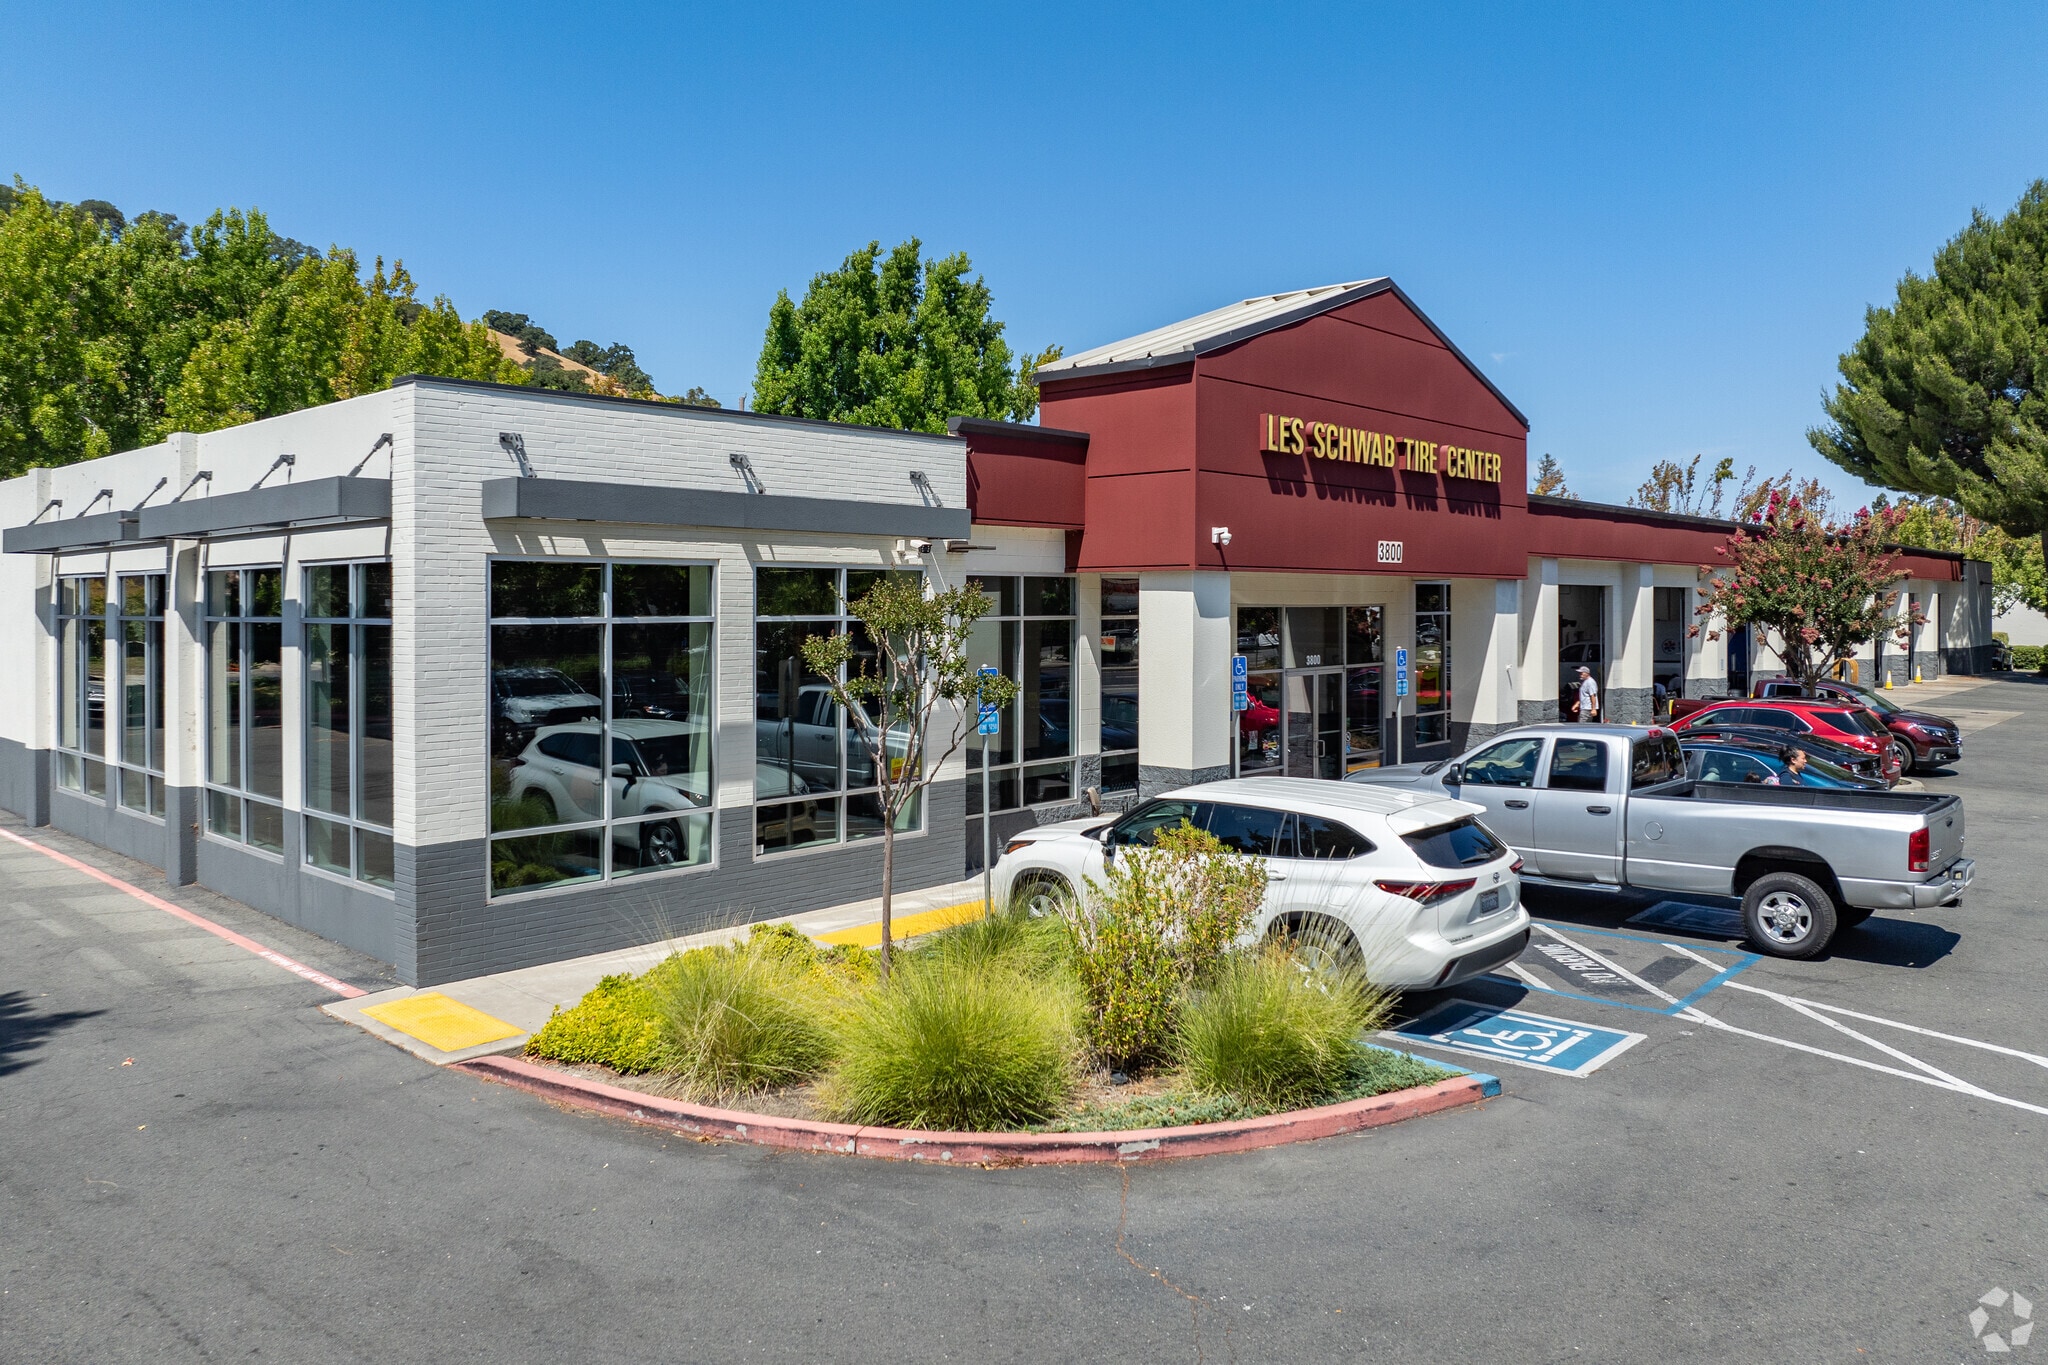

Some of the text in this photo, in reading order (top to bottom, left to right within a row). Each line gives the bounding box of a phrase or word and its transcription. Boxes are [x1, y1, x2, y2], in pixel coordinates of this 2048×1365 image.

[1268, 413, 1502, 483] LES SCHWAB TIRE CENTER
[1379, 542, 1402, 561] 3800
[1306, 654, 1321, 666] 3800
[1533, 943, 1606, 971] PARKING
